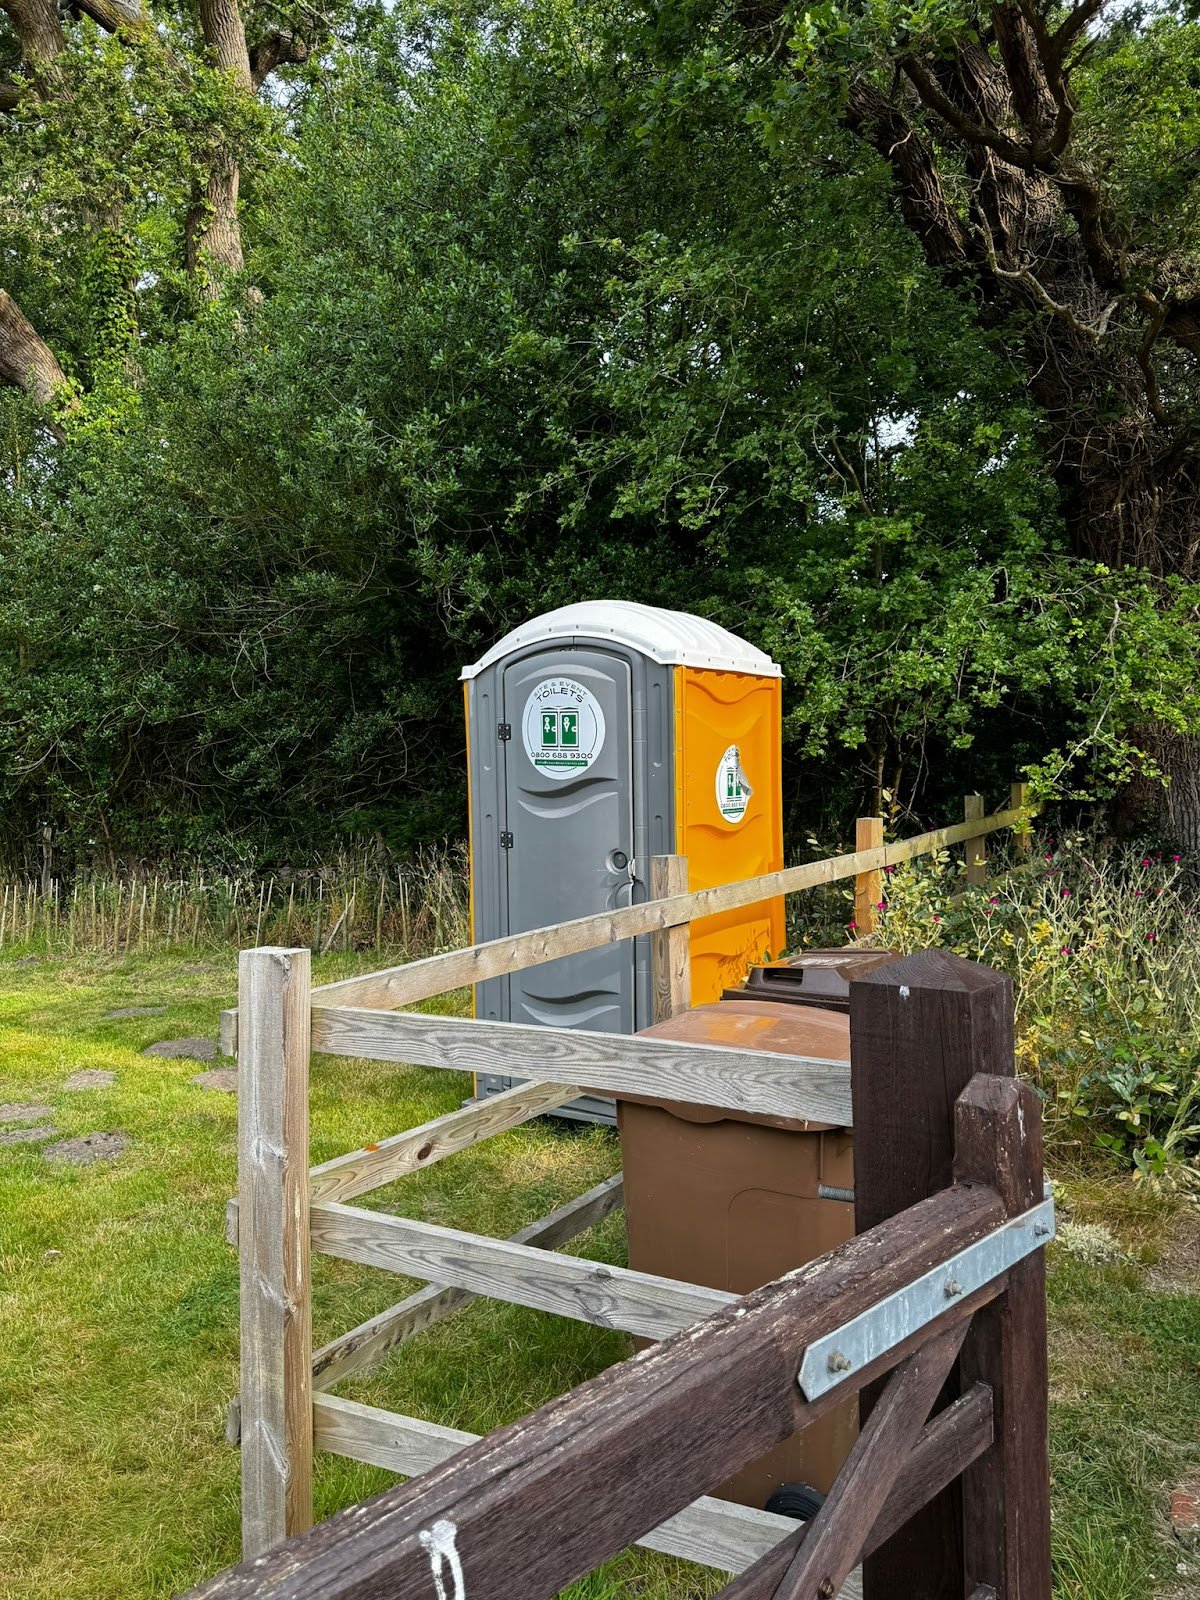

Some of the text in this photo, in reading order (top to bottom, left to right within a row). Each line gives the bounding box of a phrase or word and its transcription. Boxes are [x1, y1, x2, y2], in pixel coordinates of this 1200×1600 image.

[533, 683, 549, 697] SITE
[559, 681, 588, 696] EVENT
[536, 687, 584, 703] TOILETS
